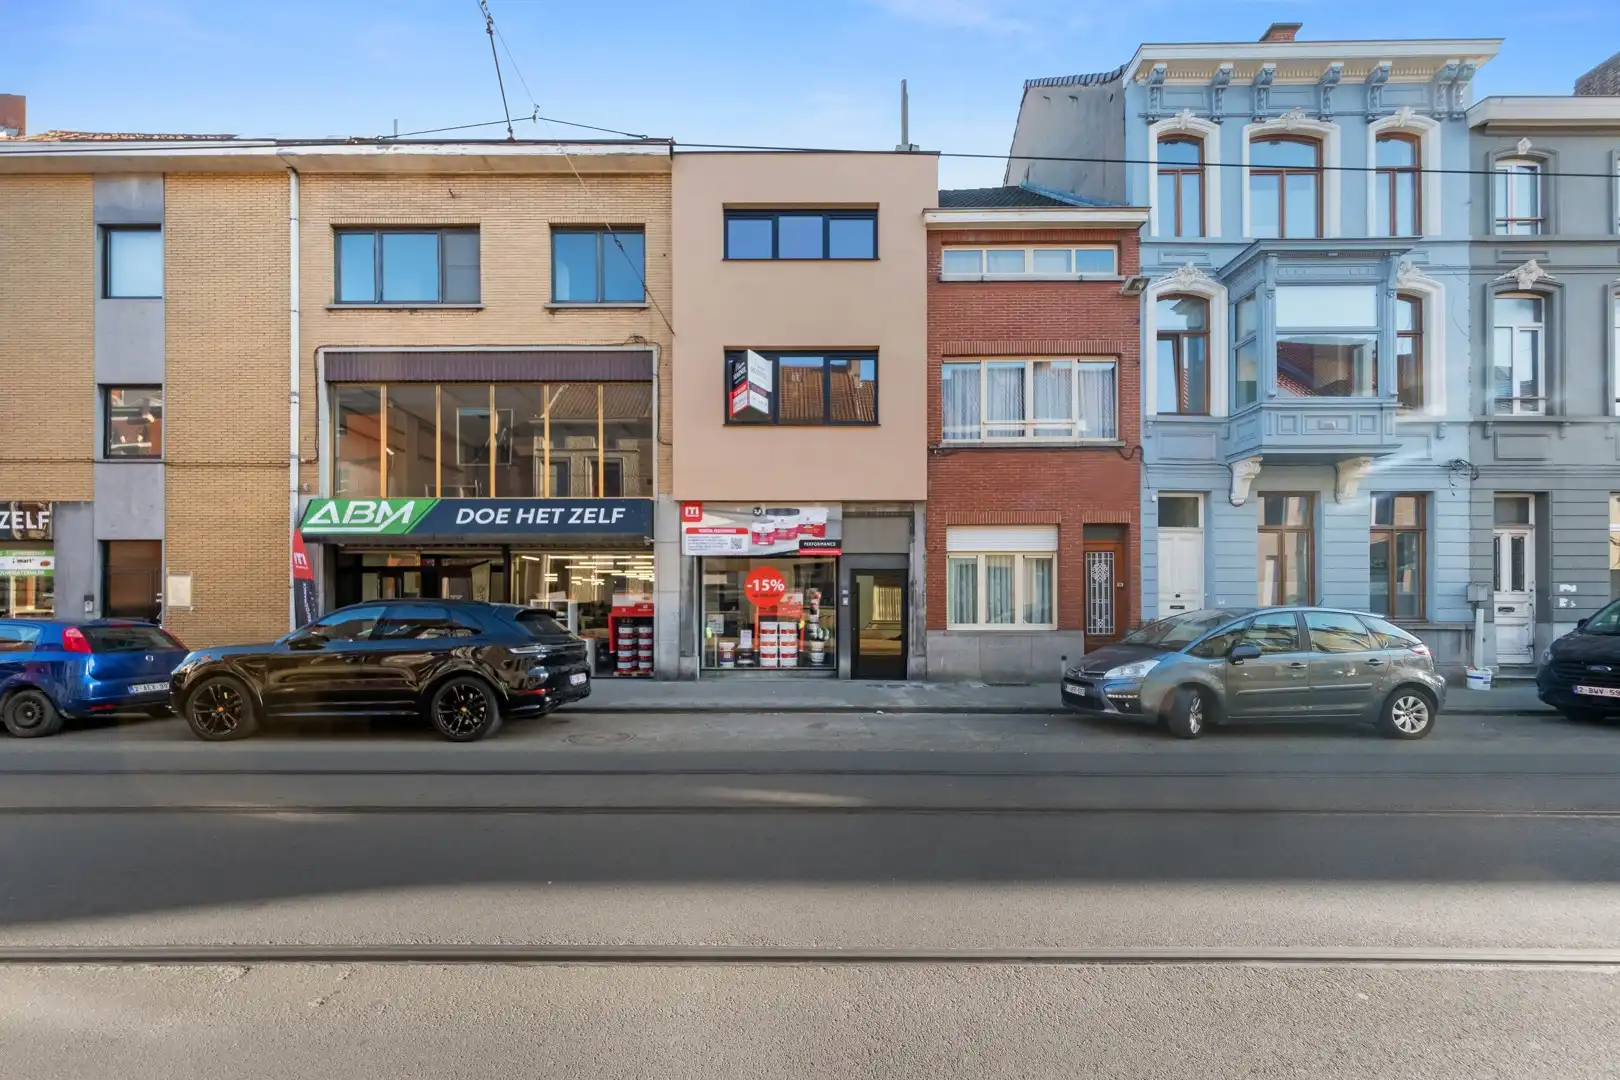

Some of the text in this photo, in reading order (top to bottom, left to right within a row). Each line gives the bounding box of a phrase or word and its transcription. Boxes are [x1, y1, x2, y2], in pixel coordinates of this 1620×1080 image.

[0, 511, 50, 529] ZELF
[307, 500, 415, 524] ABM
[455, 506, 626, 525] DOE HET ZELF
[746, 578, 785, 592] -15%
